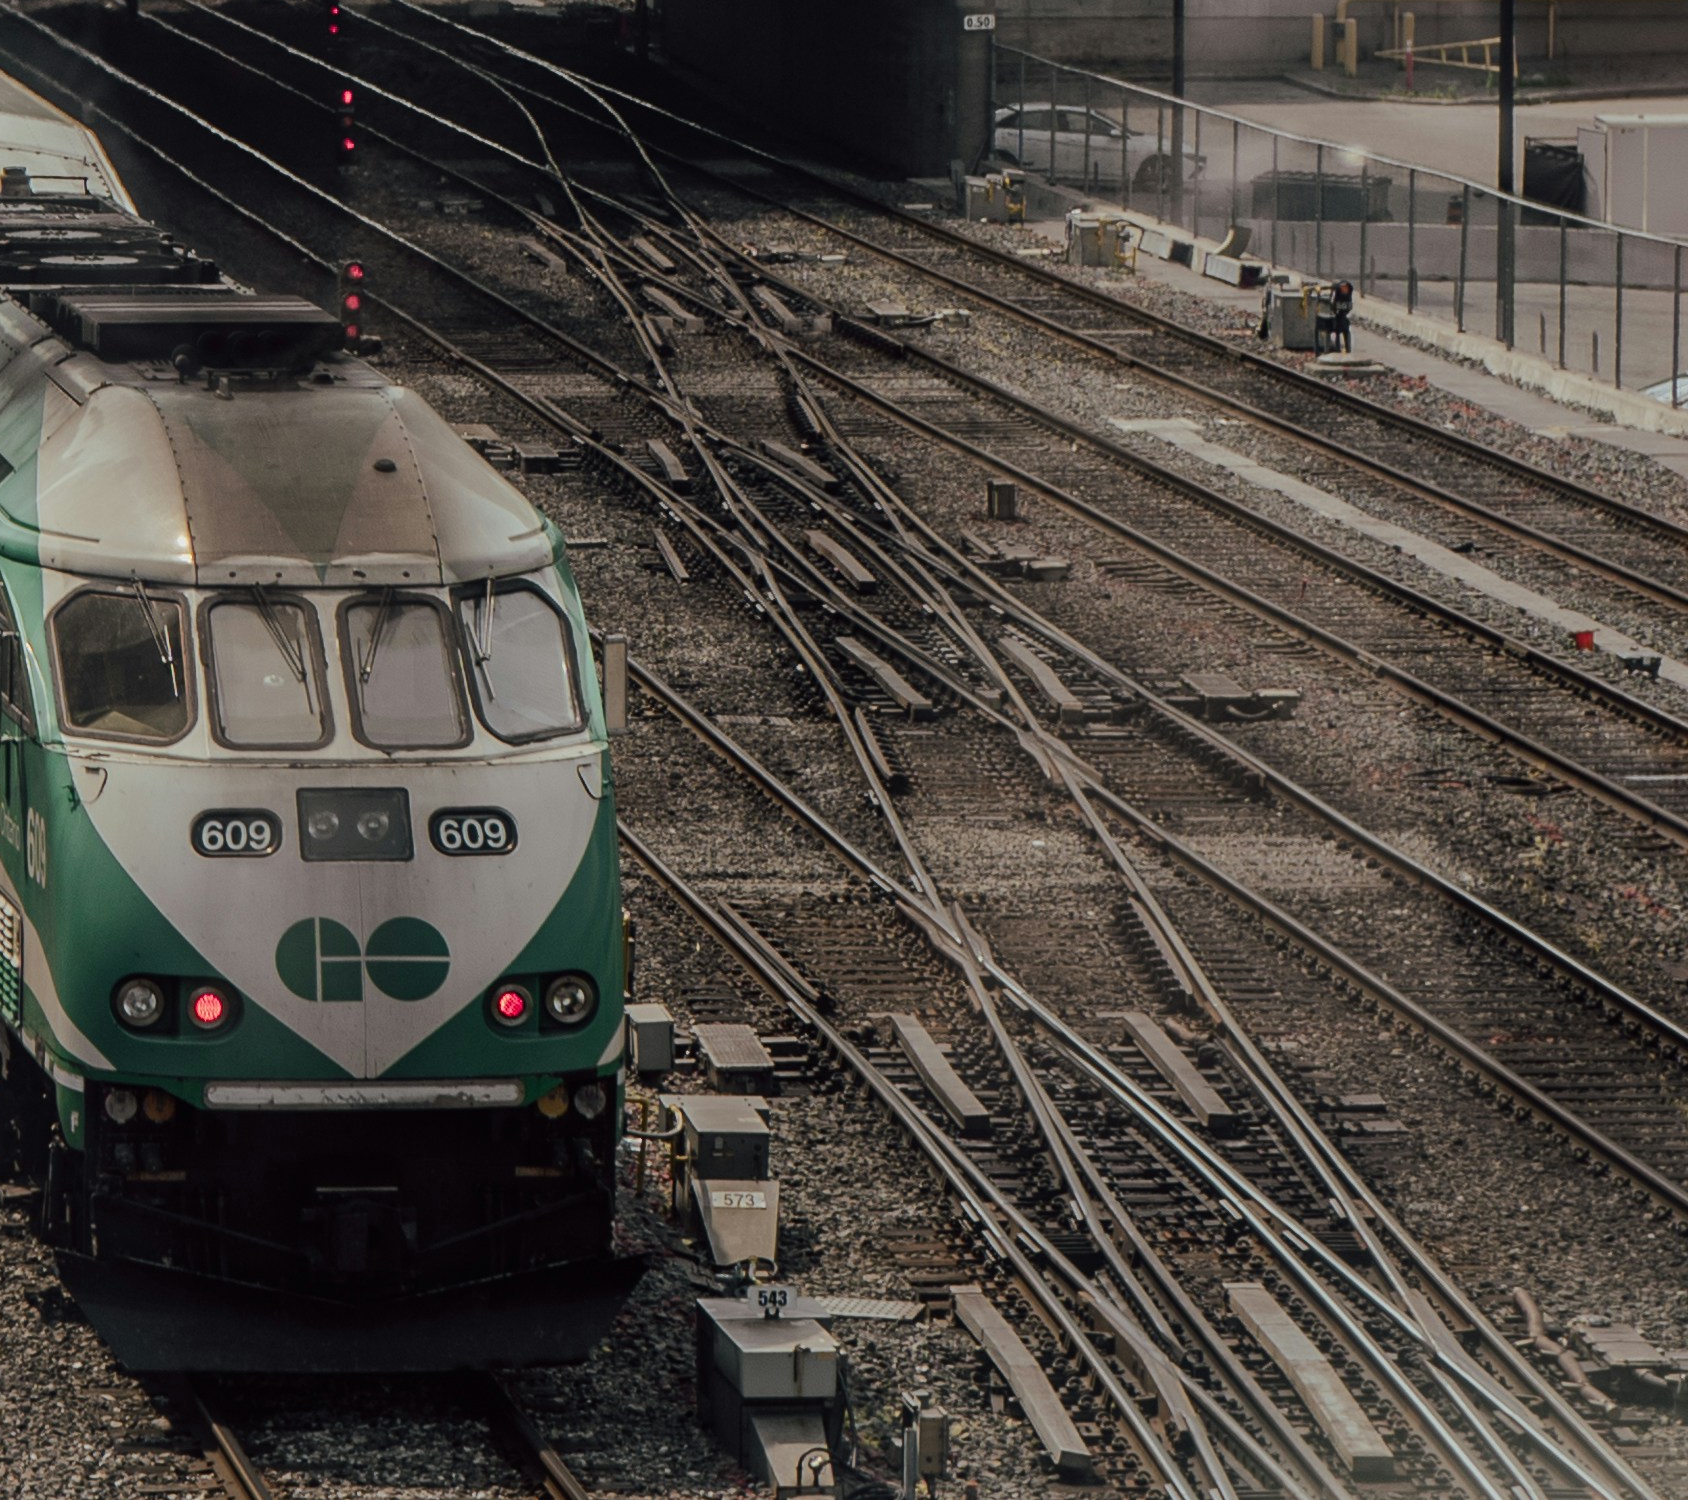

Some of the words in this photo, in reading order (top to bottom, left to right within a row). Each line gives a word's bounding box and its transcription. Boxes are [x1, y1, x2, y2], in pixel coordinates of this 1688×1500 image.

[26, 807, 47, 889] 609
[201, 820, 272, 851] 609
[439, 818, 508, 849] 609
[275, 916, 450, 1002] GO
[724, 1192, 755, 1207] 573
[758, 1291, 787, 1306] 543
